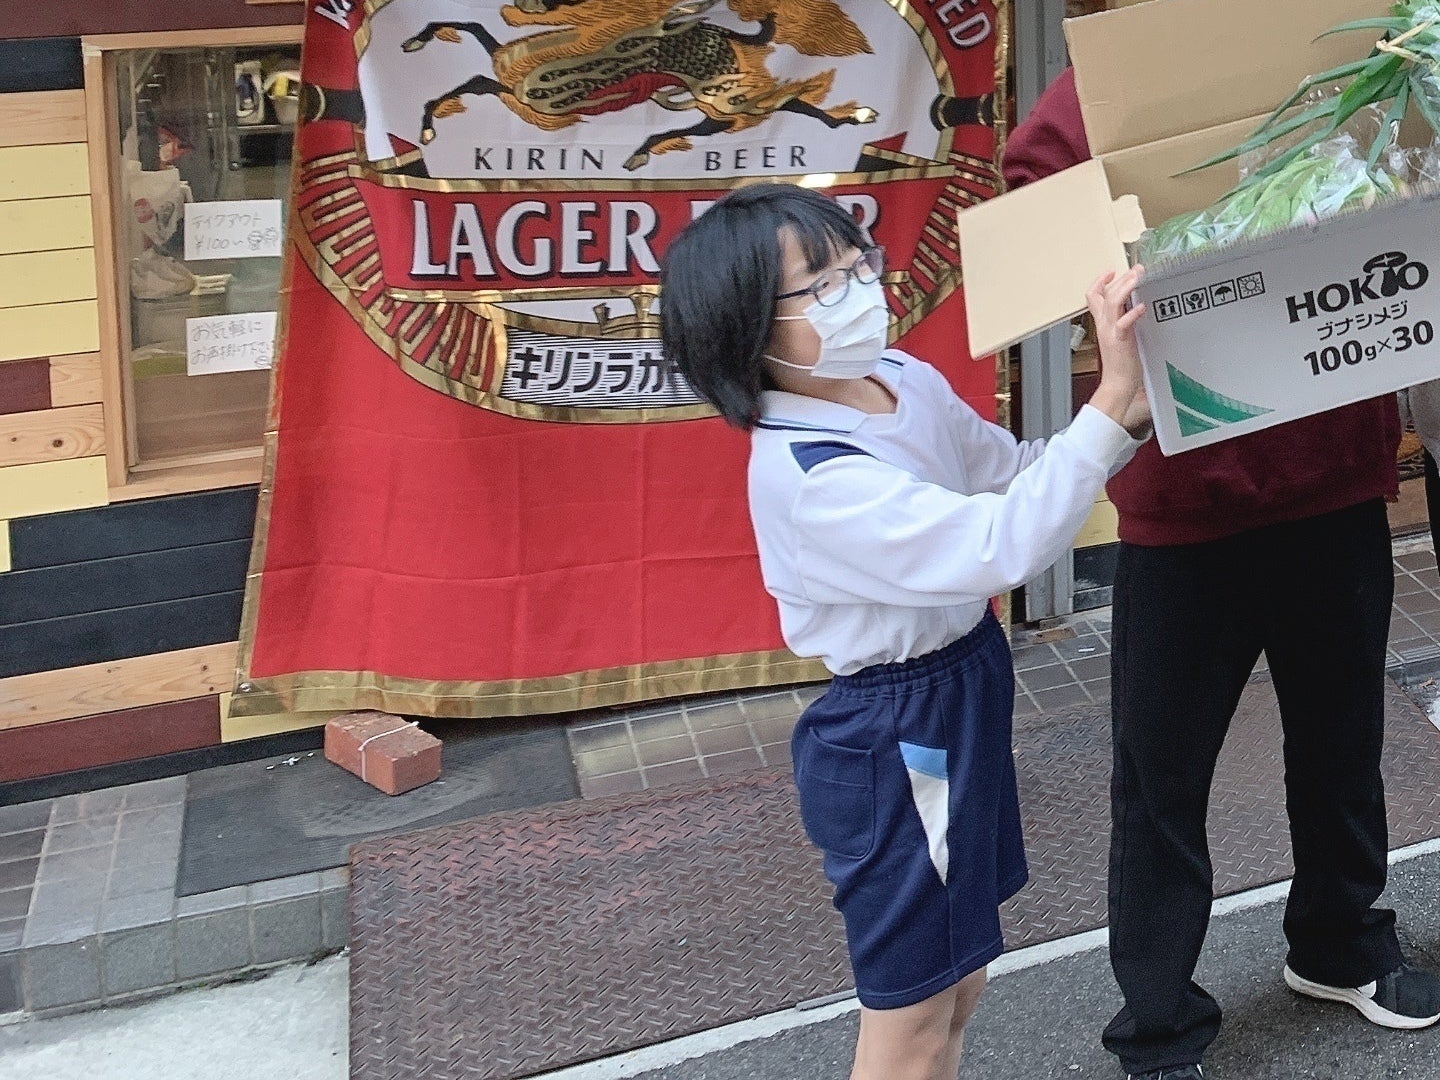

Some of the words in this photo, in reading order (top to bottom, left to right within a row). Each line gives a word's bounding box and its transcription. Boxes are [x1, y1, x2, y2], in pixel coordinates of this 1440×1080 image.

[473, 146, 605, 172] KIRIN
[704, 145, 809, 172] BEER
[410, 199, 662, 277] LAGER
[1317, 299, 1409, 341] ブナシメジ
